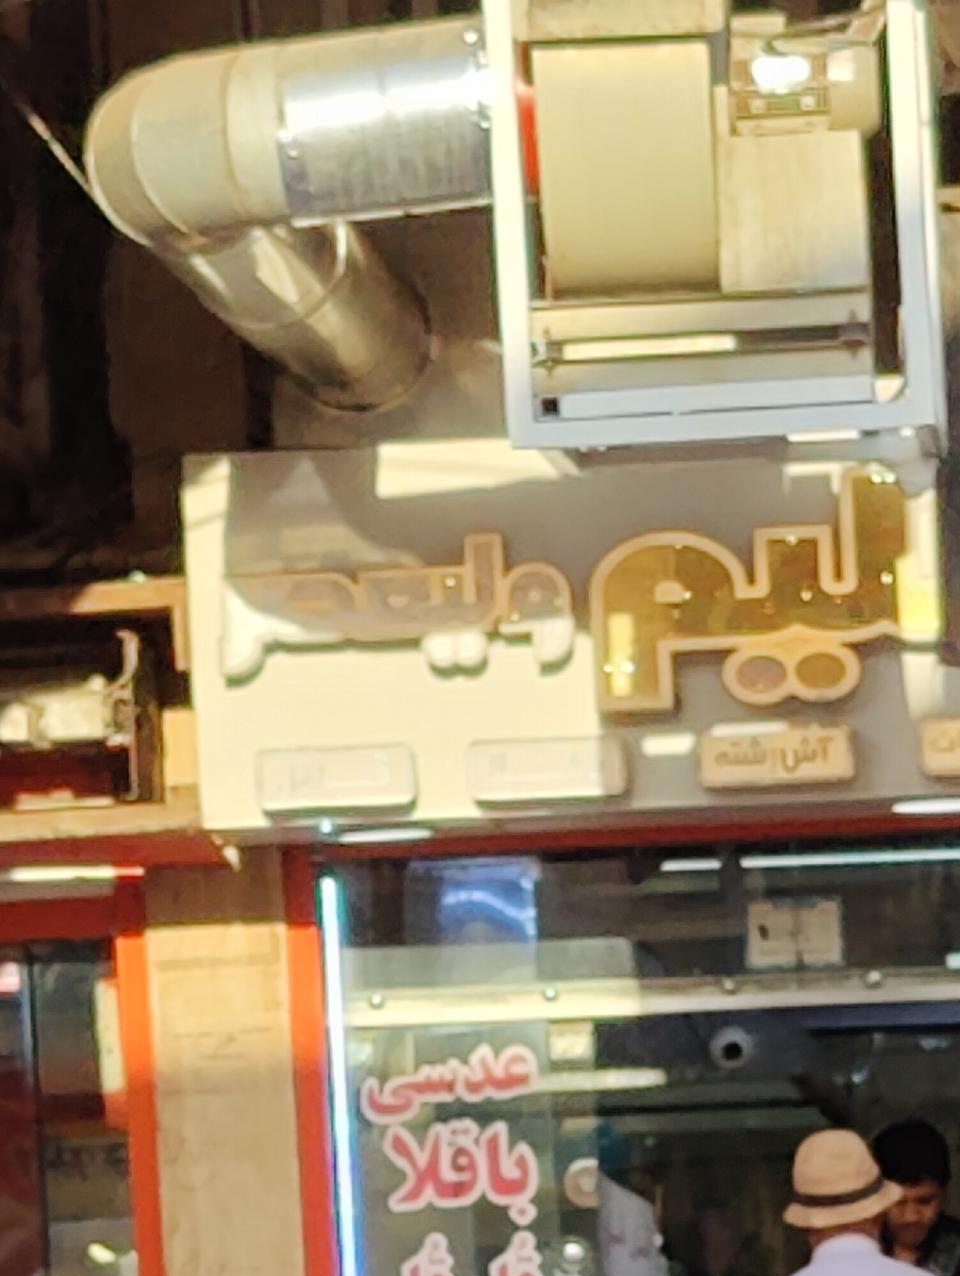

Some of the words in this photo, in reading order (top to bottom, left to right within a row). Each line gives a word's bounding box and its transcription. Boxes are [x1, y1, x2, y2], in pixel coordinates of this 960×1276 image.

[778, 735, 835, 774] آش
[361, 1045, 537, 1121] عدسی
[385, 1119, 538, 1225] باقلا
